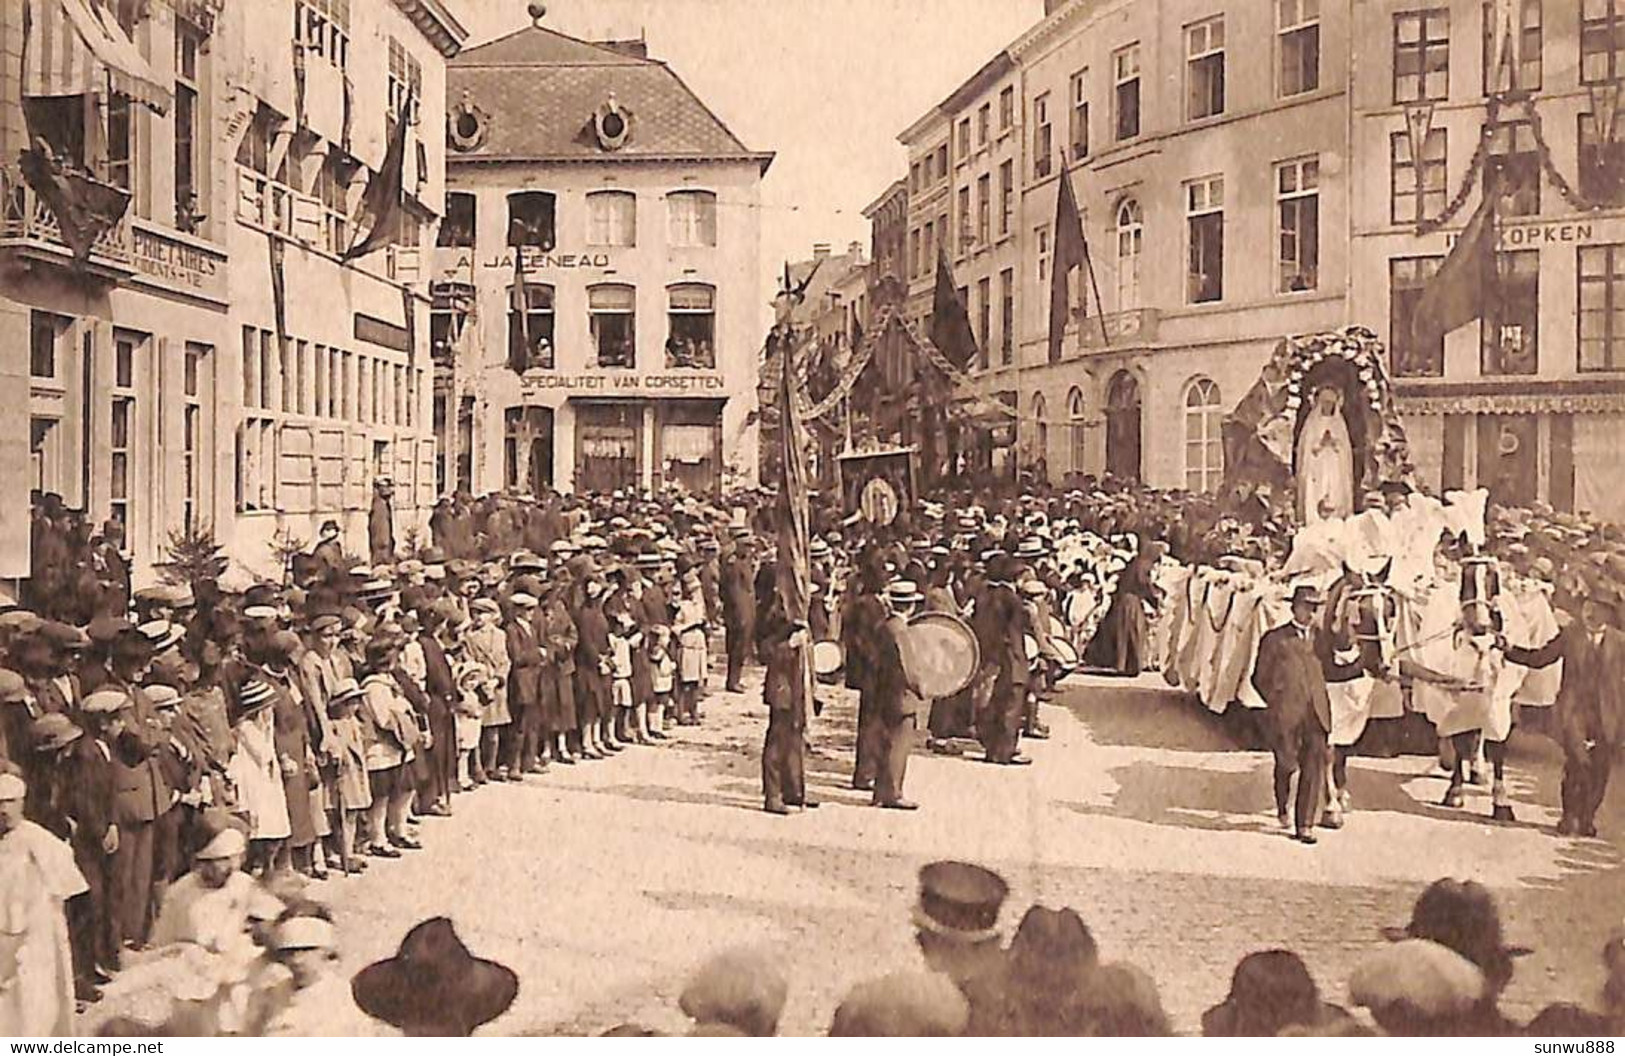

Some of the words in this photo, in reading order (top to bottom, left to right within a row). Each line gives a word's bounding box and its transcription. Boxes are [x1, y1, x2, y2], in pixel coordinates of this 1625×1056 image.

[520, 375, 606, 389] SPECIALITEIT
[613, 375, 640, 389] VAN
[645, 375, 725, 389] CORSETTEN
